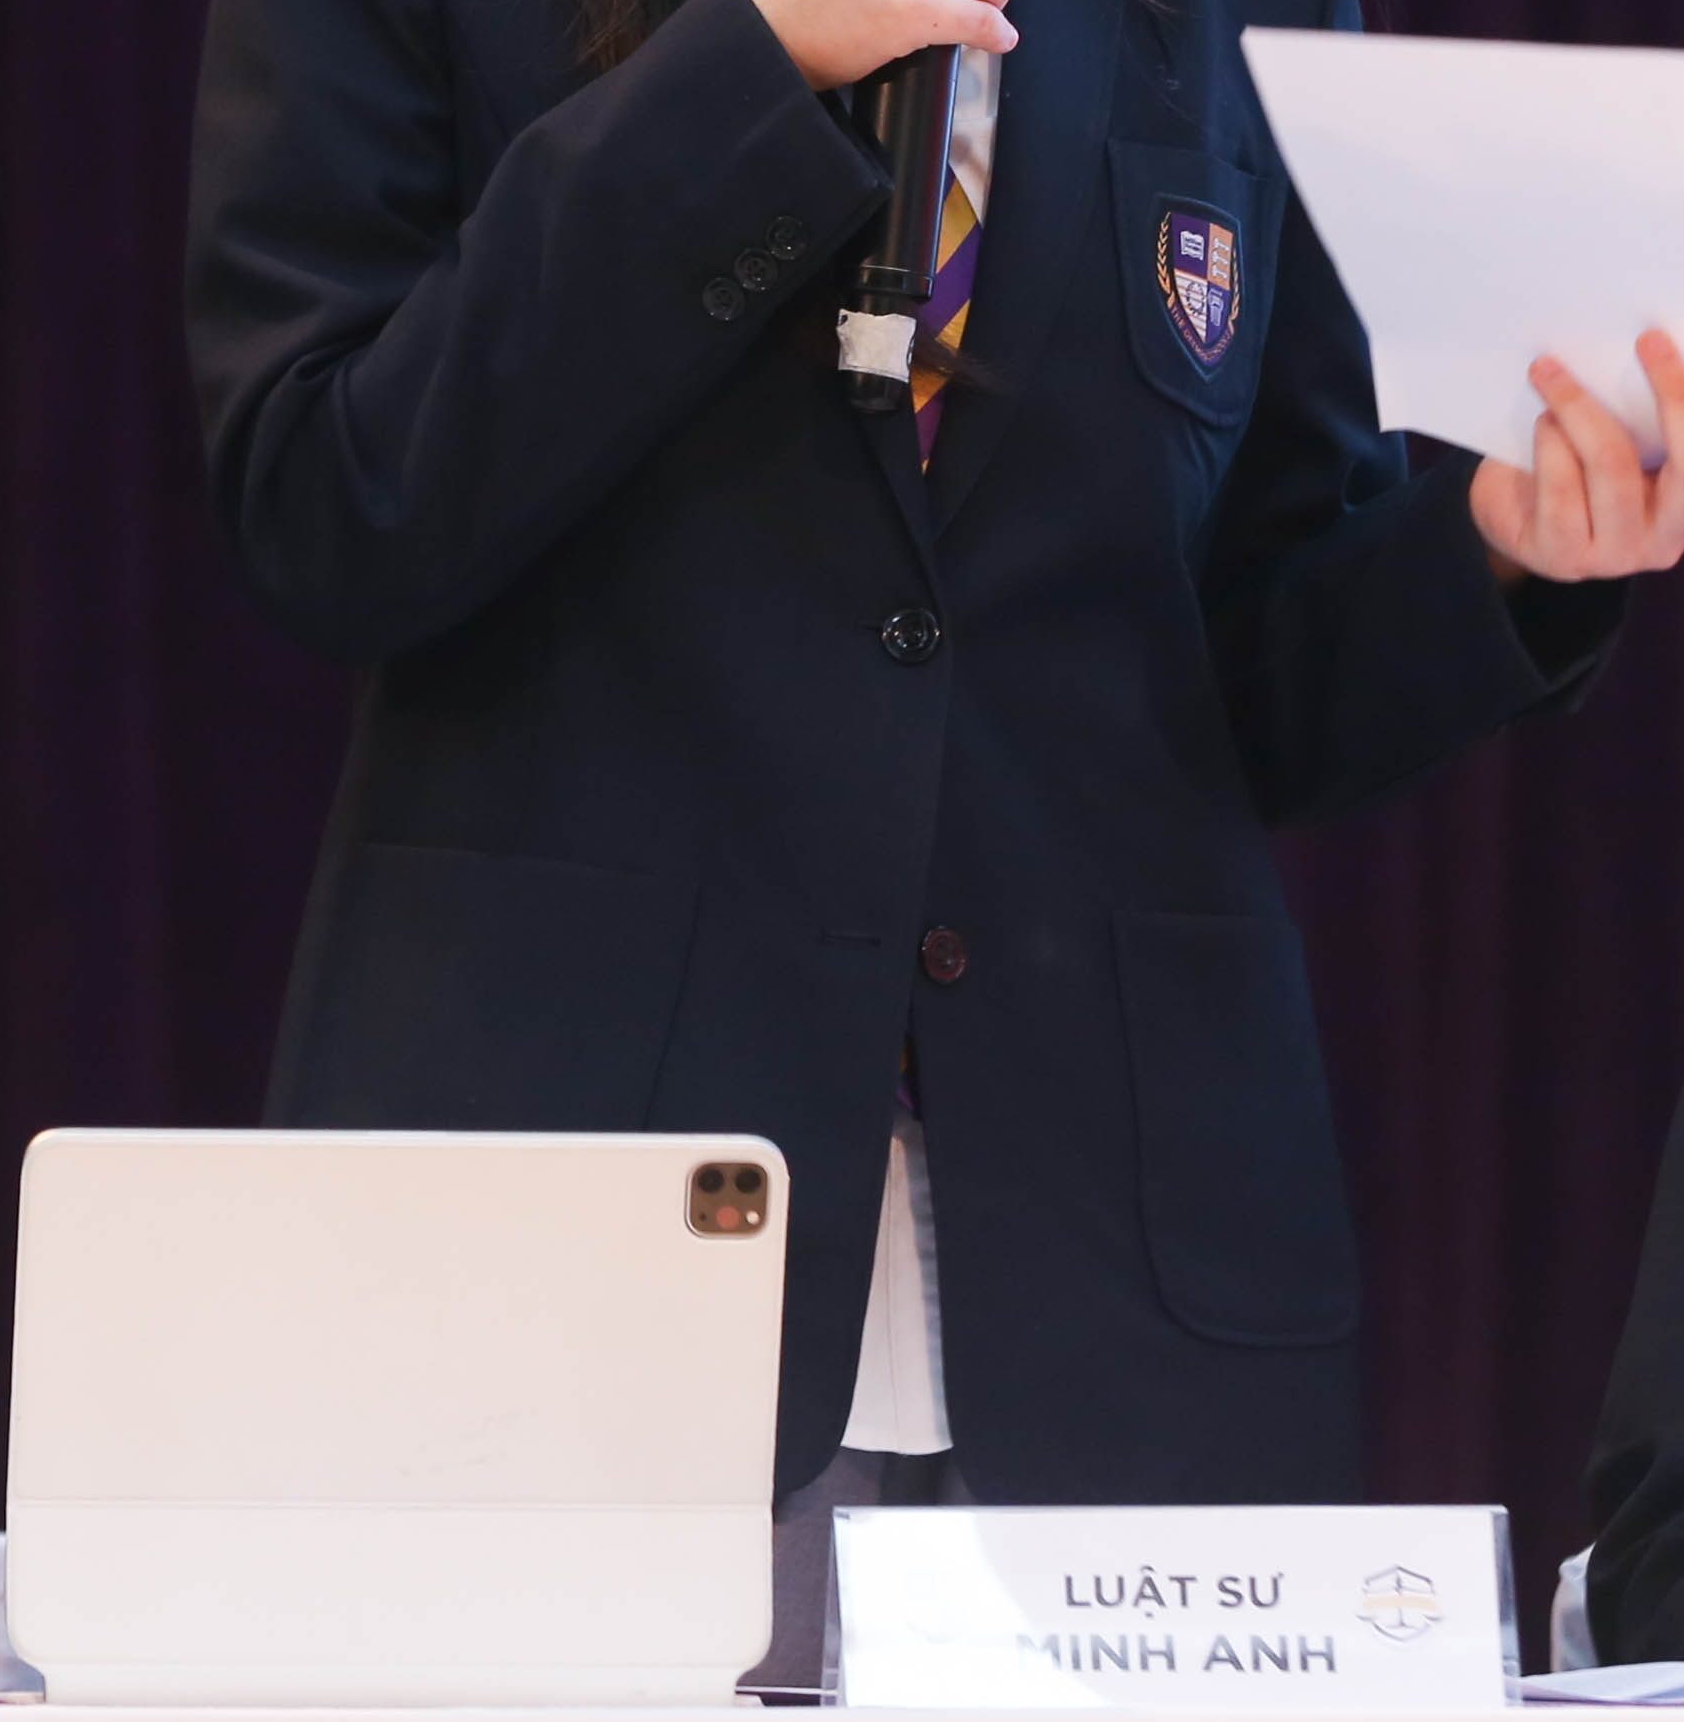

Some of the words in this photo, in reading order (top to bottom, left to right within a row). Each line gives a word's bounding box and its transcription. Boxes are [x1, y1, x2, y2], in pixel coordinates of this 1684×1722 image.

[1065, 1565, 1197, 1618] LUẬT
[1217, 1571, 1284, 1609] SƯ
[1203, 1635, 1337, 1673] ANH
